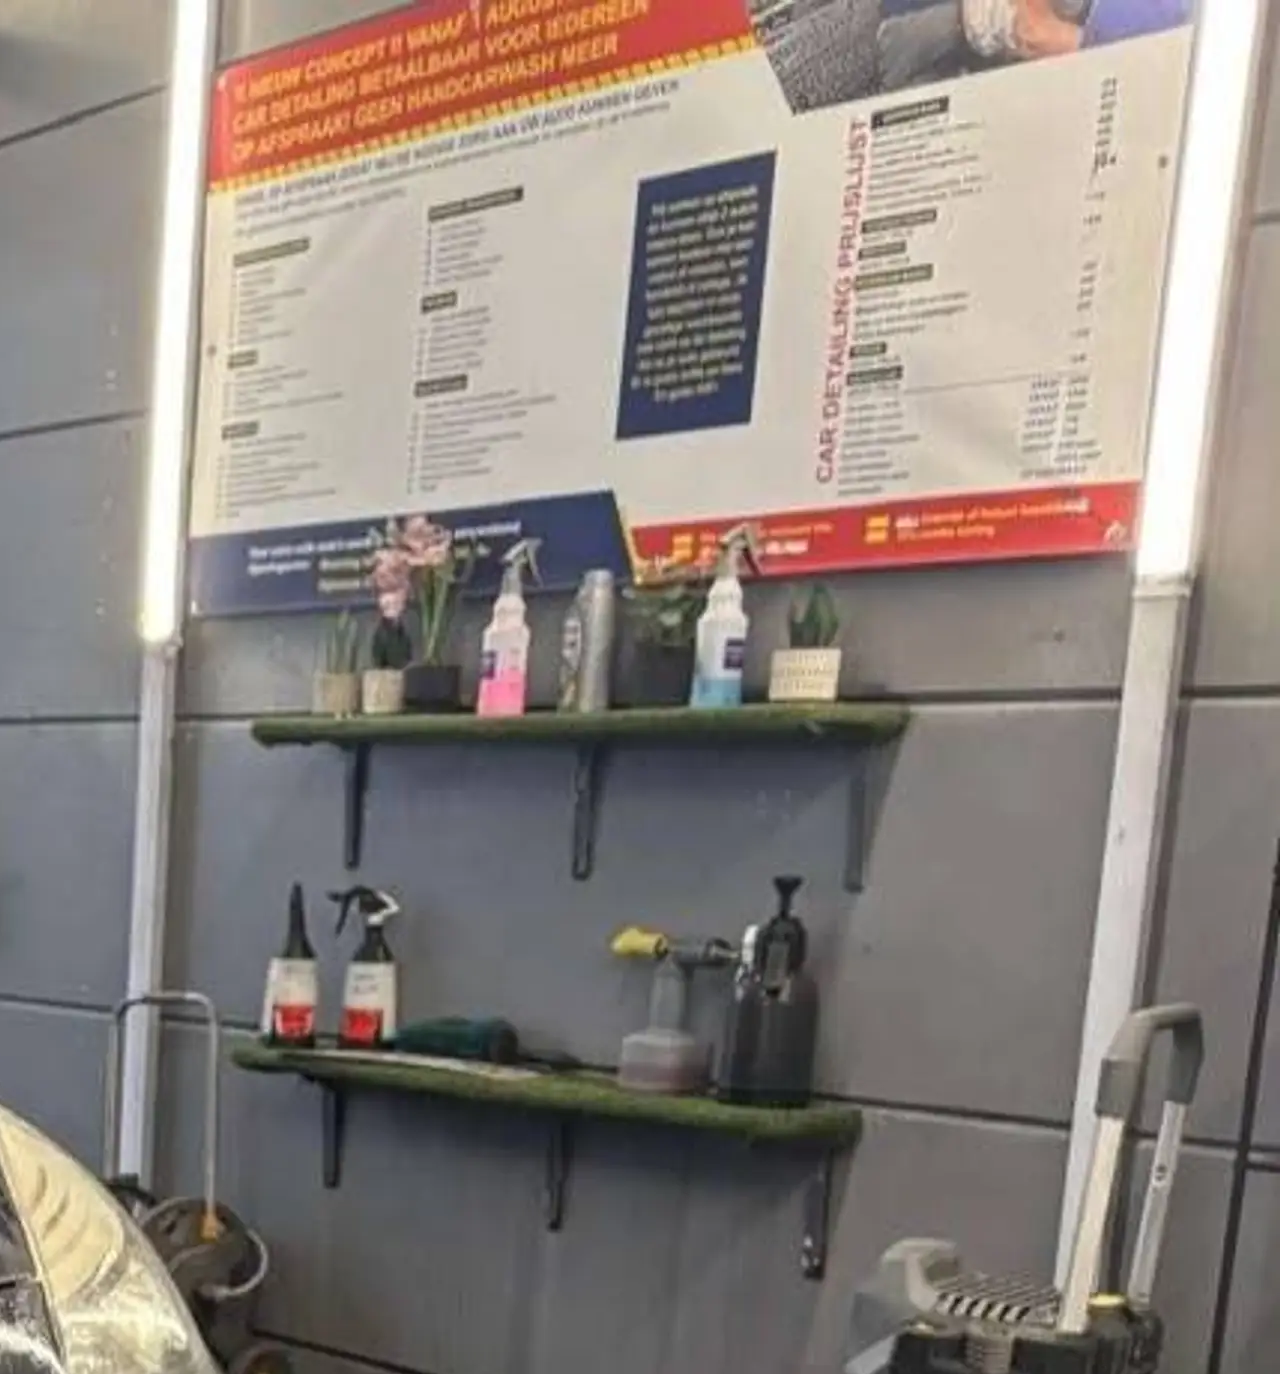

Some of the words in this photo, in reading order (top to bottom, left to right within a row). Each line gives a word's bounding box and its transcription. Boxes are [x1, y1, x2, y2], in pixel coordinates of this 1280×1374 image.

[232, 104, 268, 135] CAR
[484, 24, 541, 56] VOOR
[353, 95, 403, 127] GEEN
[406, 52, 555, 111] HANDCARWASH
[560, 32, 618, 69] MEER
[822, 275, 852, 420] DETAILING
[816, 426, 838, 484] CAR
